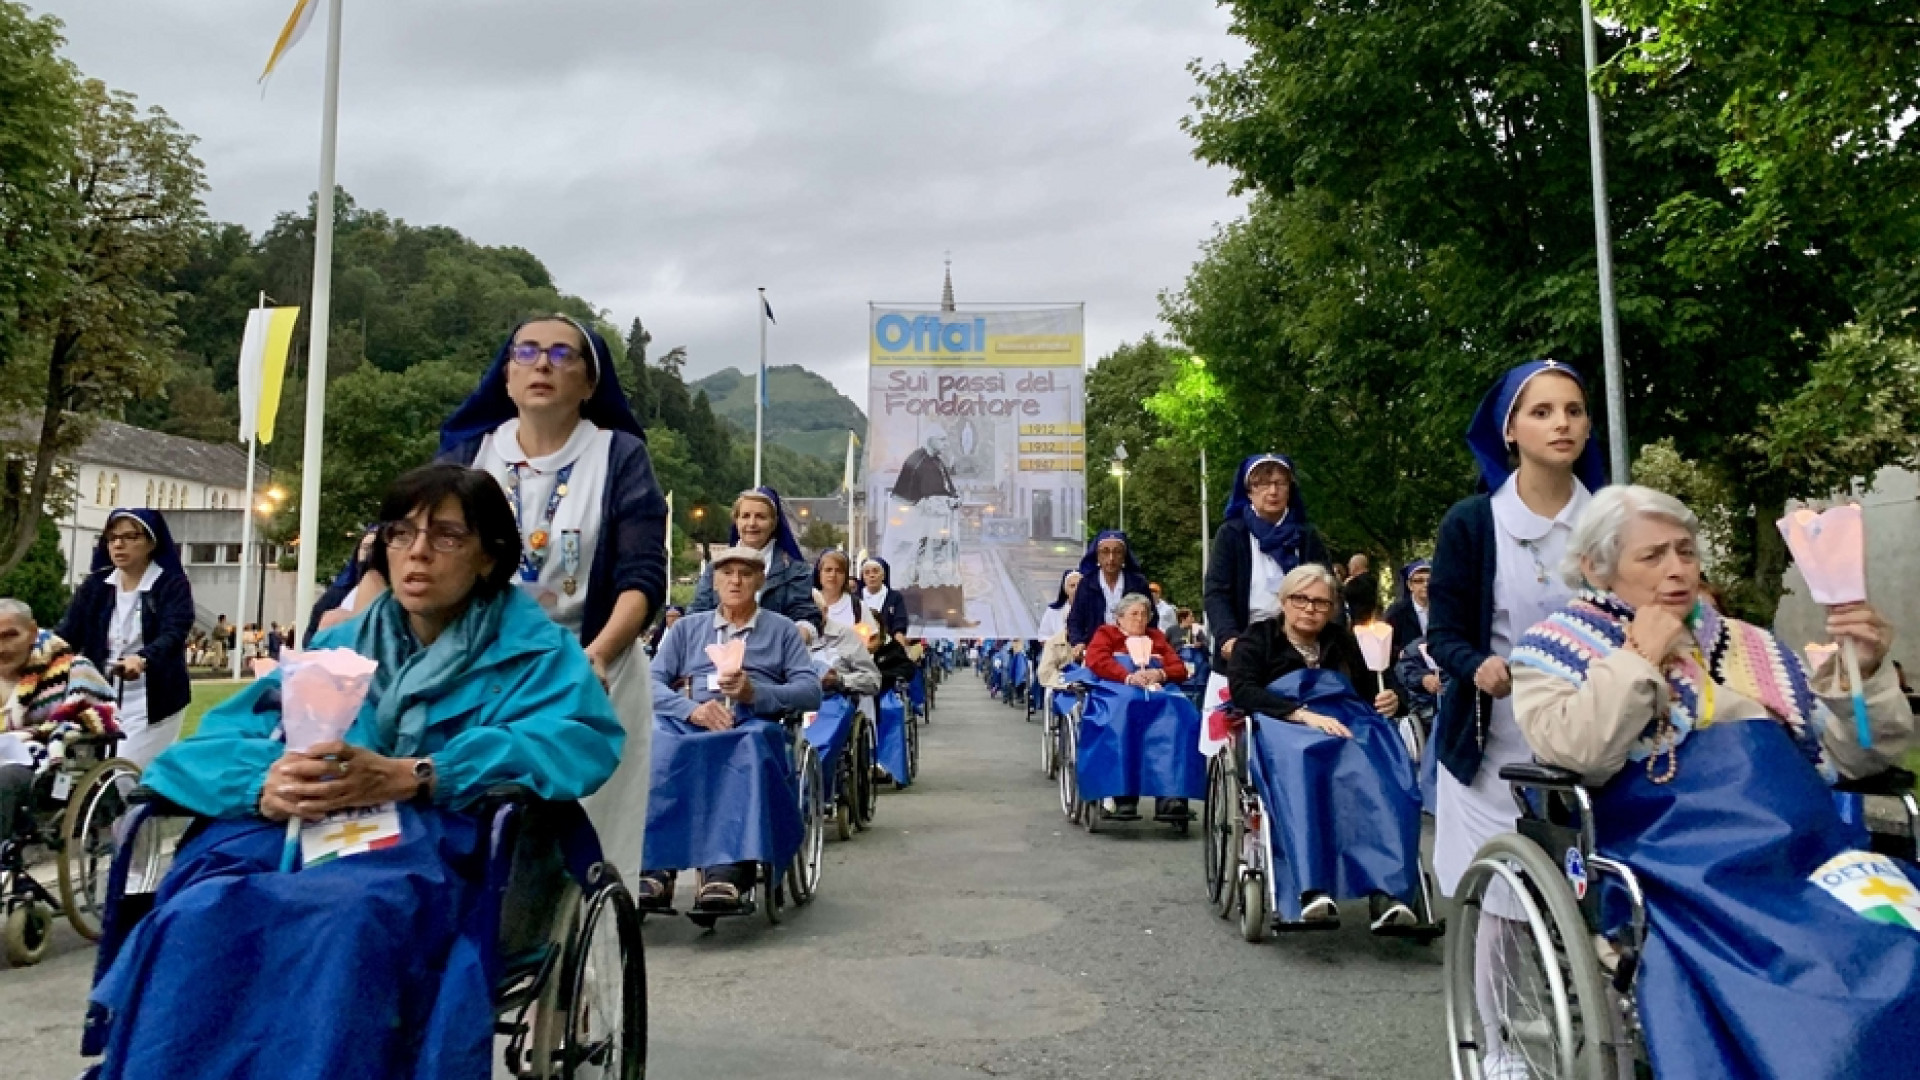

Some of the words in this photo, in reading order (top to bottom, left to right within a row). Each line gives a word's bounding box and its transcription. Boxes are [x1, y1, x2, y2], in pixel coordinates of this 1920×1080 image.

[876, 314, 985, 352] Oftal
[887, 370, 928, 392] Sui
[938, 372, 1005, 400] passi
[1015, 370, 1055, 392] del
[885, 391, 1041, 416] Fondatore
[1028, 424, 1056, 435] 1912
